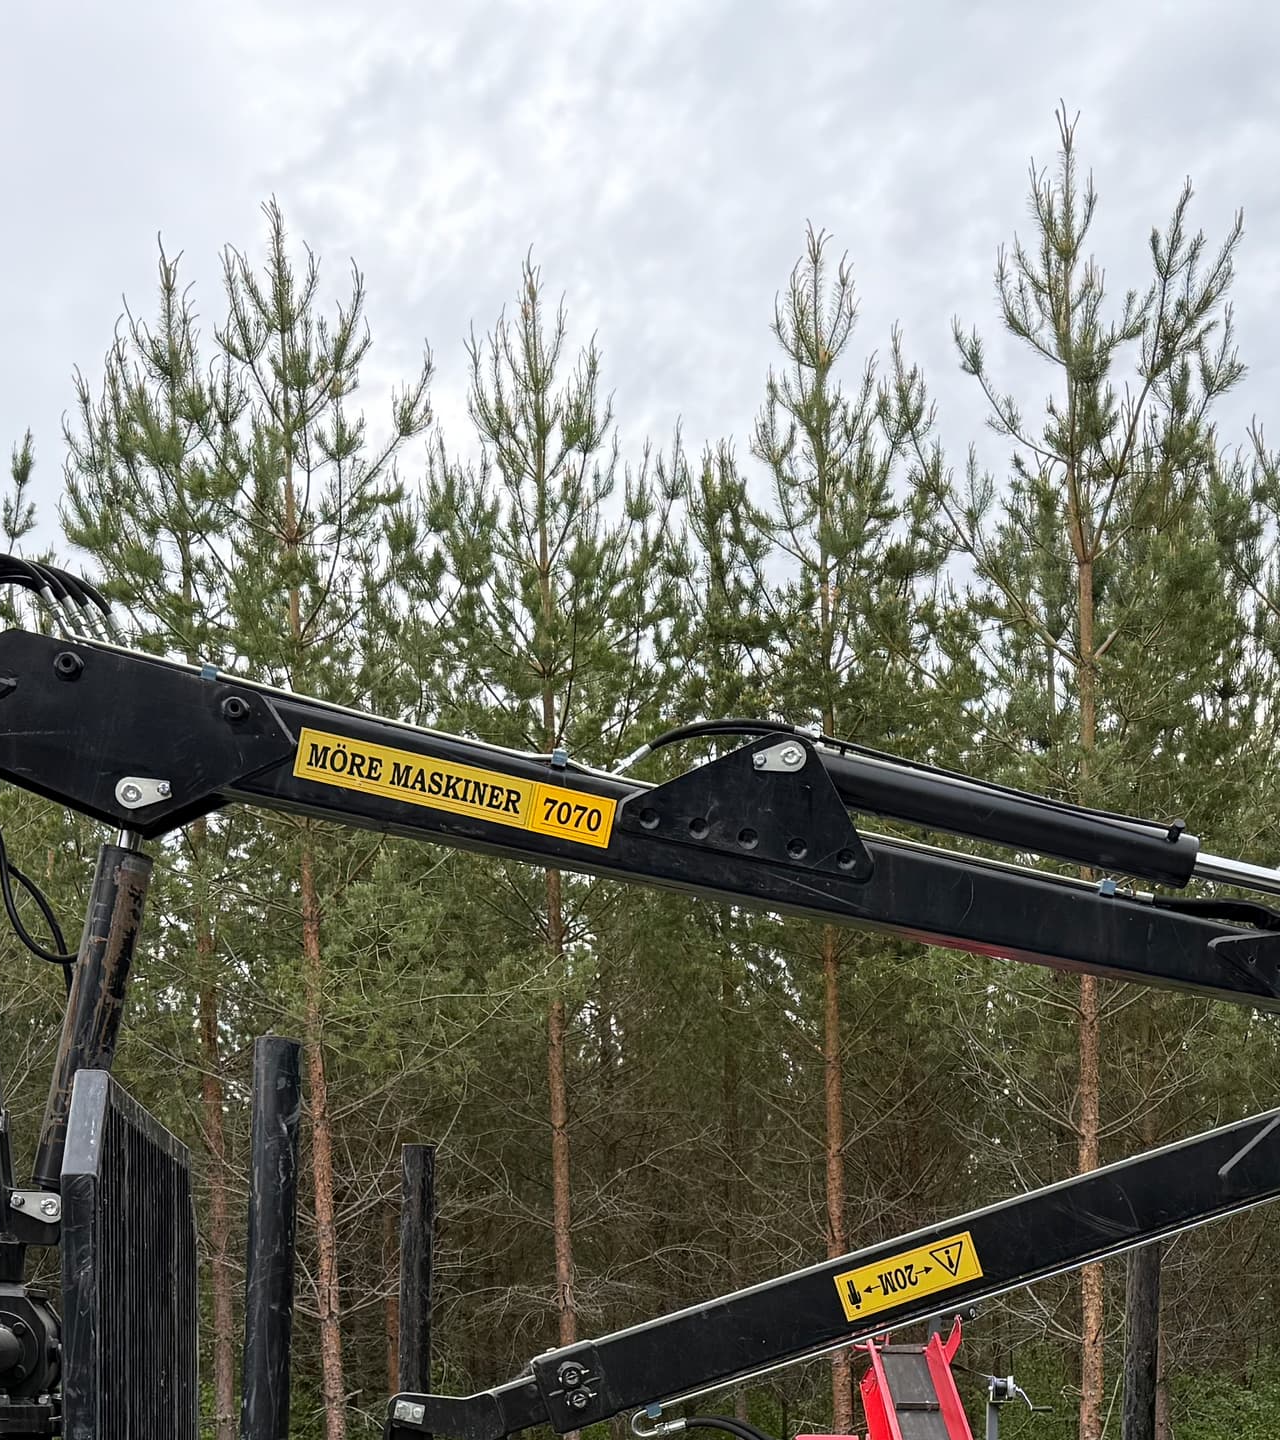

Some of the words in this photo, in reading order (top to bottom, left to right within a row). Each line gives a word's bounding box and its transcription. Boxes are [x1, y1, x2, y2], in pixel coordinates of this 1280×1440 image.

[306, 743, 383, 781] MÖRE
[390, 762, 522, 815] MASKINER
[542, 797, 602, 832] 7070
[877, 1264, 918, 1296] 20M
